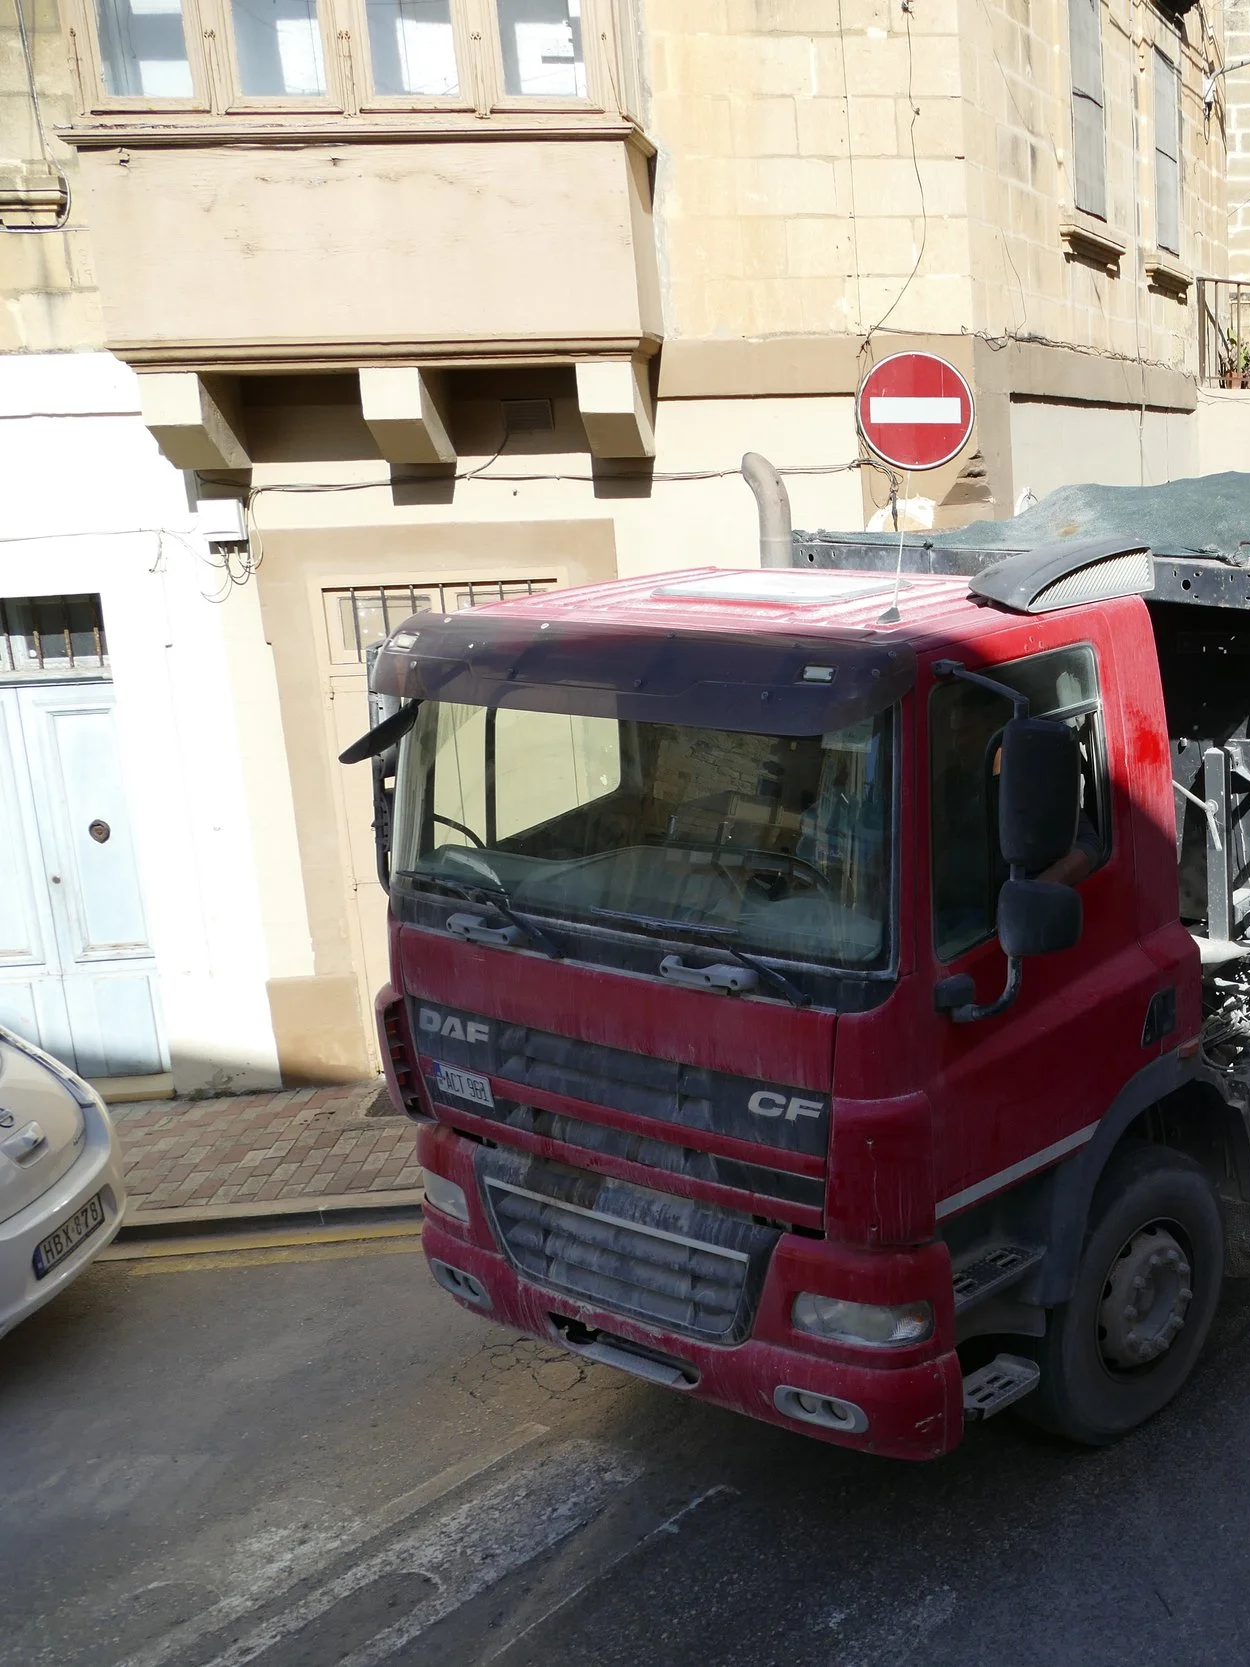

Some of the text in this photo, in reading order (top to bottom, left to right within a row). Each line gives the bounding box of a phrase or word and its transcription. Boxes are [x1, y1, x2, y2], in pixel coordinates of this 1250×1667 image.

[418, 1008, 489, 1044] DAF
[446, 1071, 464, 1094] ACT
[748, 1090, 825, 1120] CF
[43, 1201, 98, 1264] HBX 878
